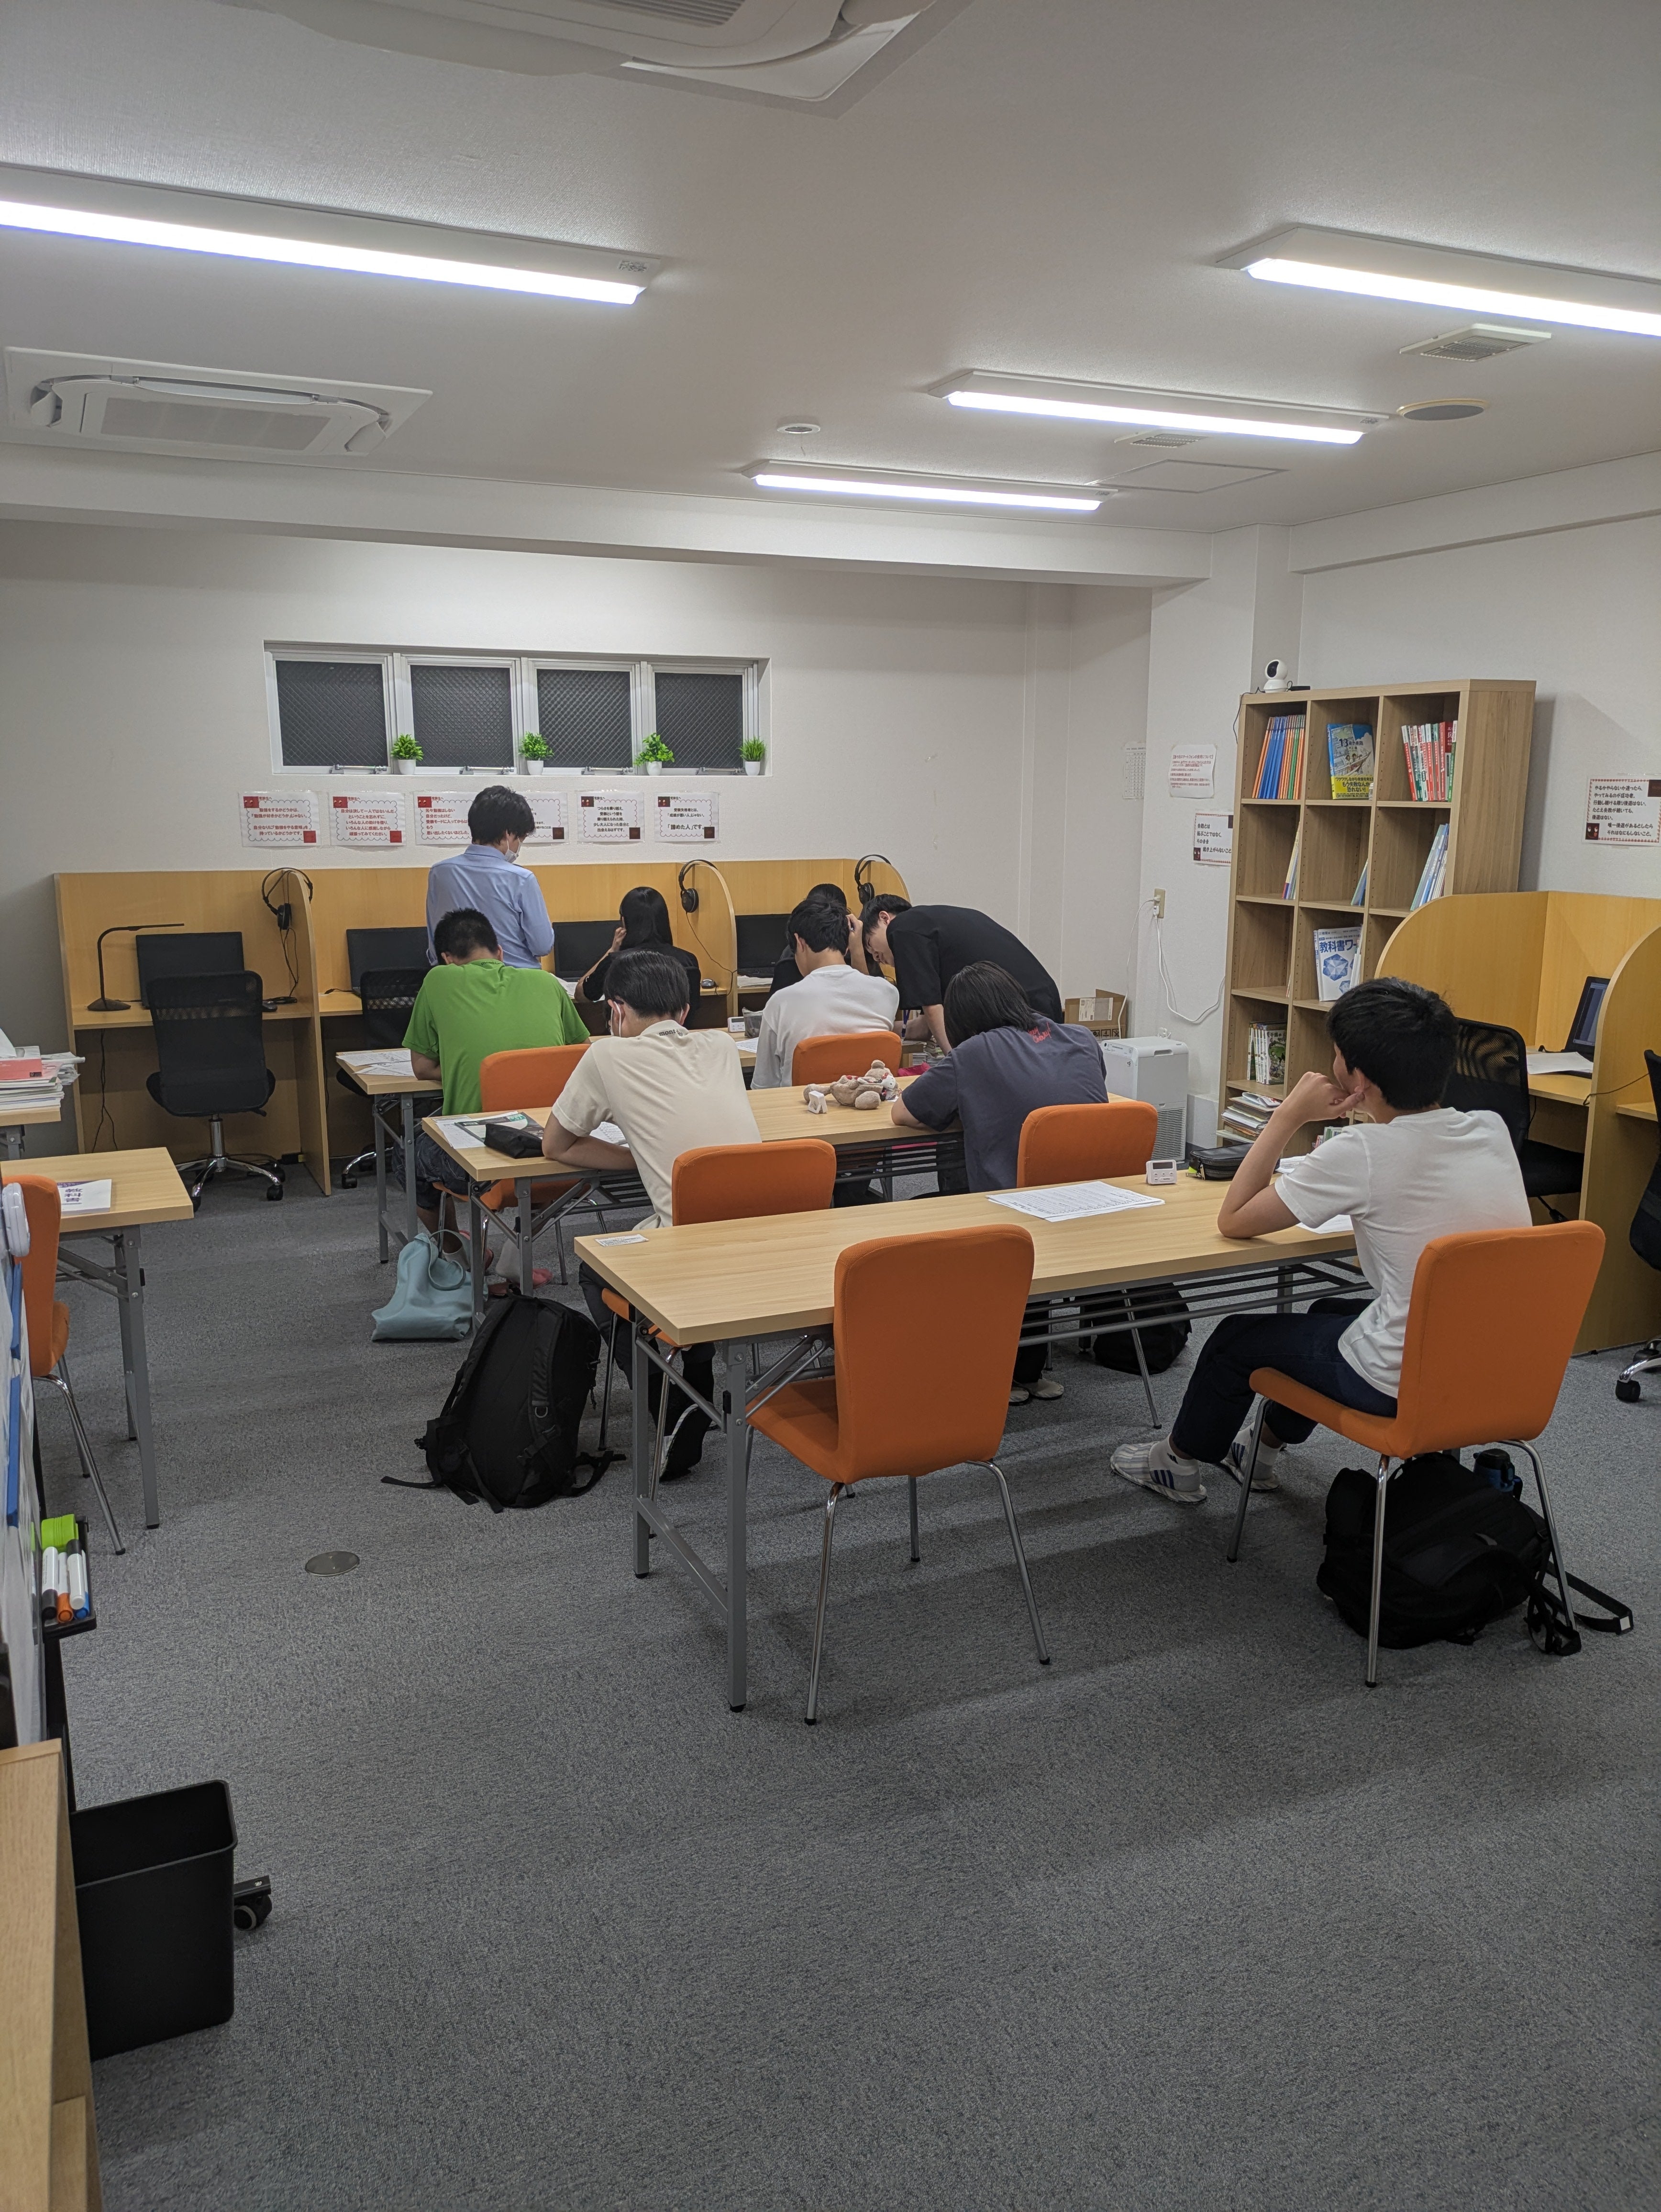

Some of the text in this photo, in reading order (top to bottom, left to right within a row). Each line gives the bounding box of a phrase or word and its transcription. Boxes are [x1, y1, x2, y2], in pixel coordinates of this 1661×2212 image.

[1319, 940, 1357, 953] 教科書ワー
